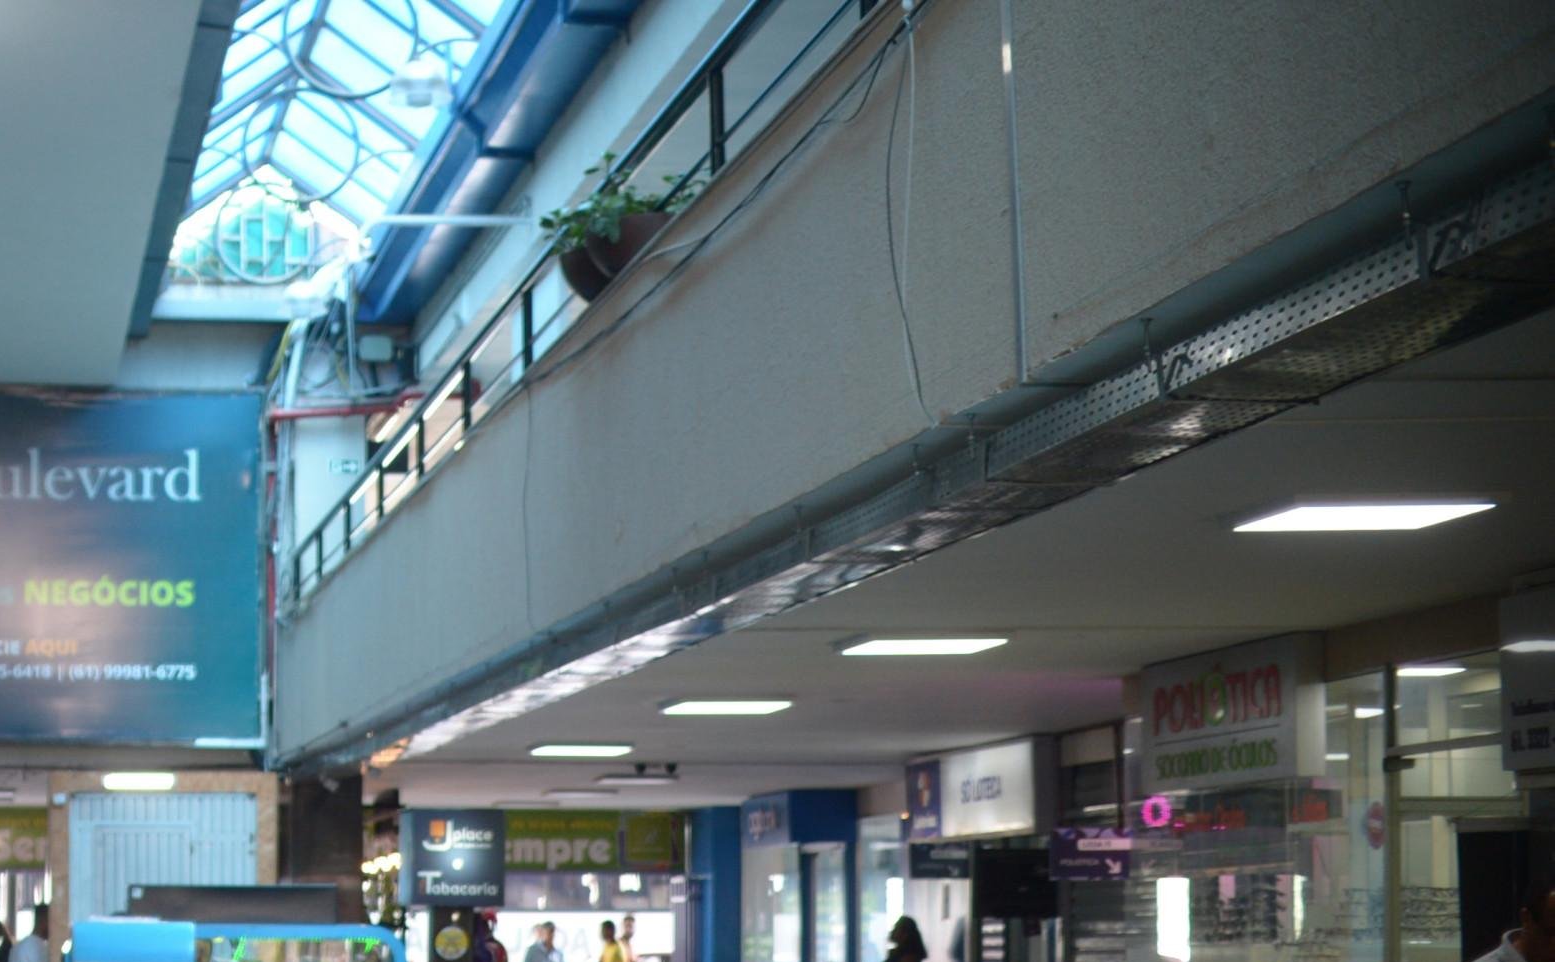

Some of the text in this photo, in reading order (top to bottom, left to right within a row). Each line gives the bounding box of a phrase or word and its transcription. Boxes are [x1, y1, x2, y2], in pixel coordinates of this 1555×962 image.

[23, 574, 196, 608] NEGÓCIOS
[25, 638, 78, 658] AQUI
[68, 662, 100, 681] (61)
[416, 870, 501, 897] Tabacaria
